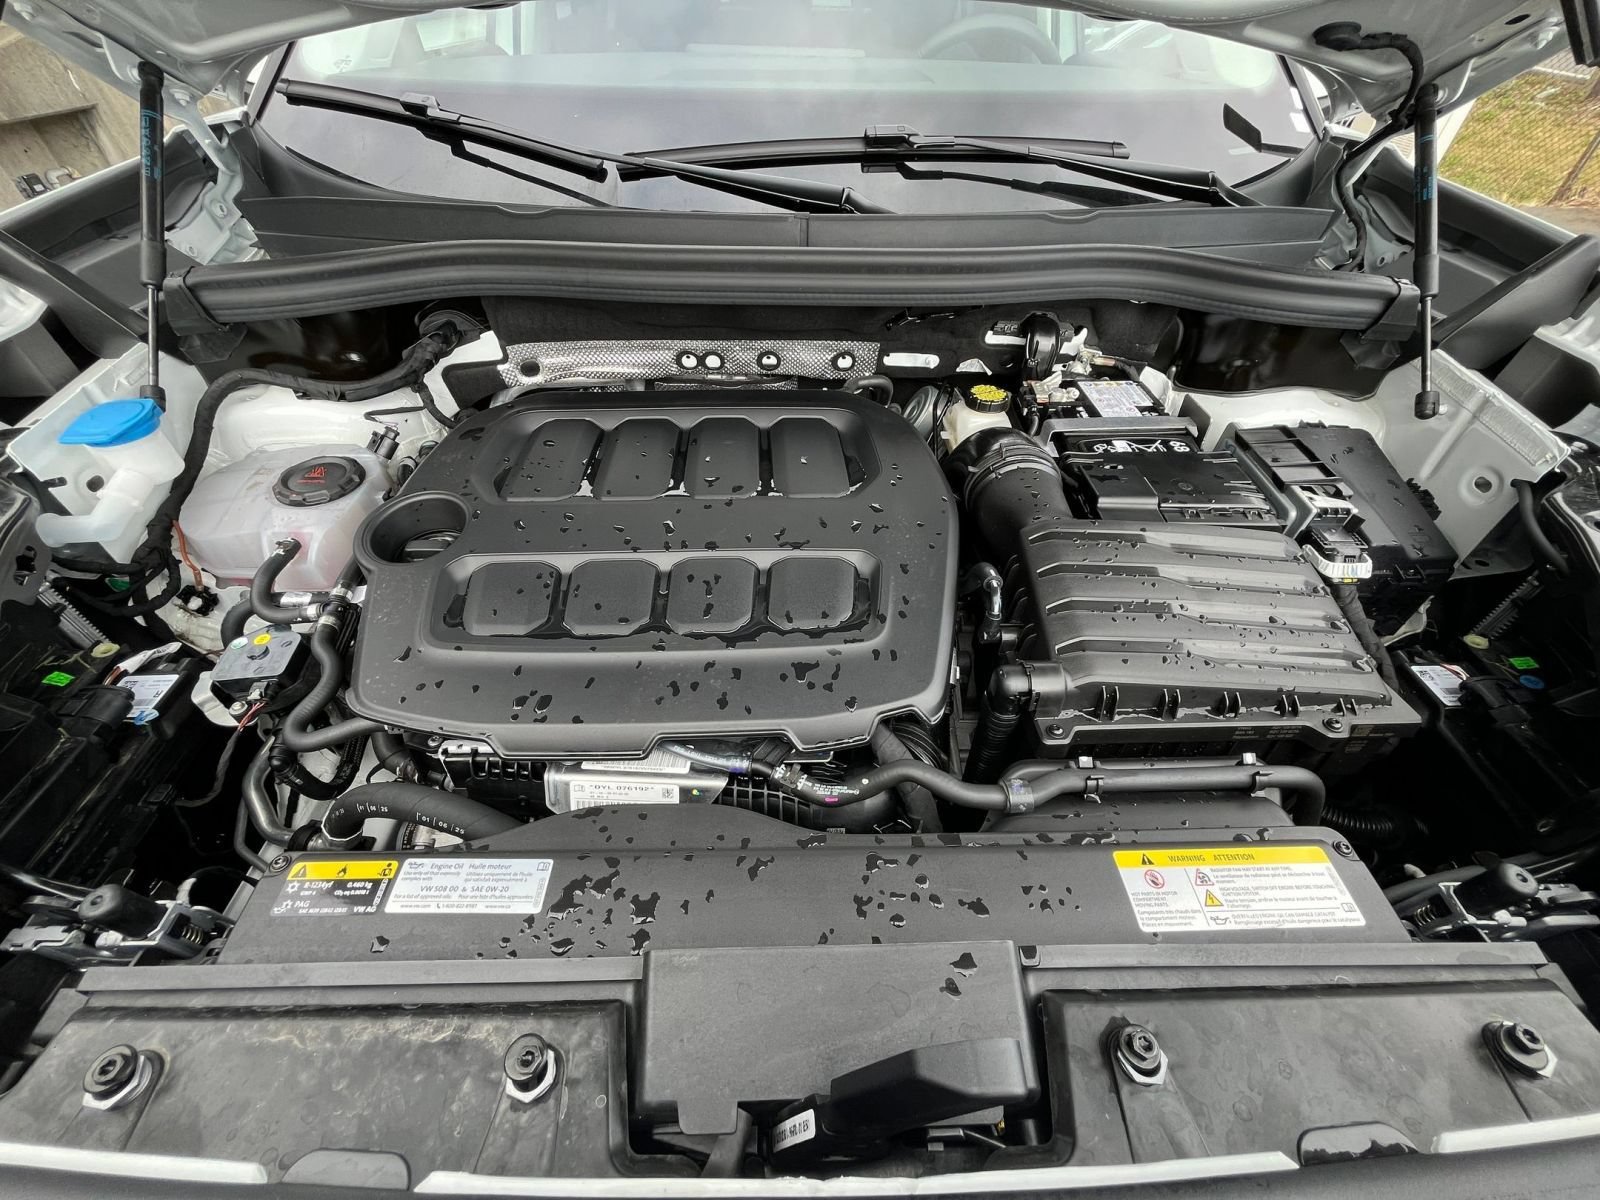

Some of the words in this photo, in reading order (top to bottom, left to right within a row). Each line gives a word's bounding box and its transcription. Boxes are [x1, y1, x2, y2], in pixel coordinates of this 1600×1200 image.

[1168, 854, 1206, 863] WARNING
[1213, 852, 1256, 861] ATTENTION
[430, 862, 453, 871] Engine
[453, 862, 465, 870] Oil
[303, 880, 335, 890] R-1234yf
[485, 885, 510, 893] 0W-20
[294, 900, 310, 908] PAG
[353, 905, 366, 913] VW
[365, 905, 377, 913] AG
